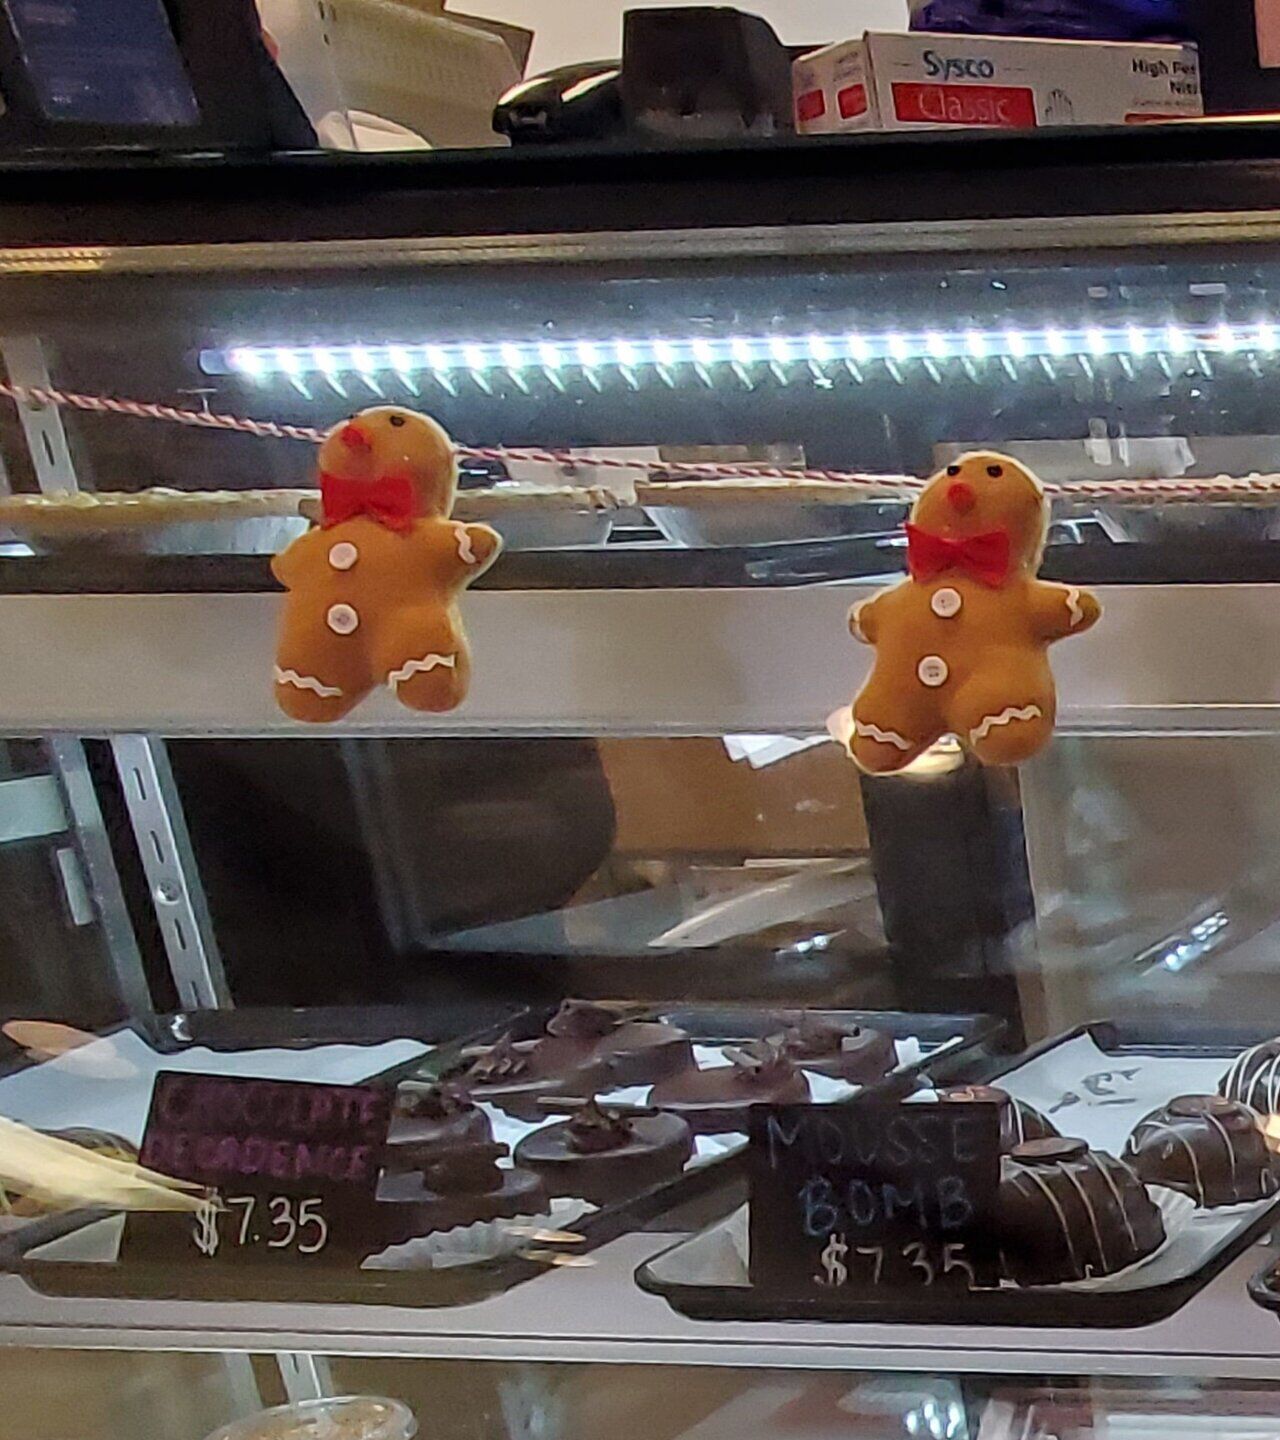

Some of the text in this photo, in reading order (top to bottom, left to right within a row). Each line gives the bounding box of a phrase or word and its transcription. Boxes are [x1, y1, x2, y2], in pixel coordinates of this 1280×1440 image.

[923, 49, 994, 80] Sysco
[1131, 58, 1169, 78] High
[917, 87, 1010, 123] Classic
[766, 1114, 980, 1169] MOUSSE
[193, 1198, 328, 1257] $7.35
[798, 1174, 974, 1236] BOMB
